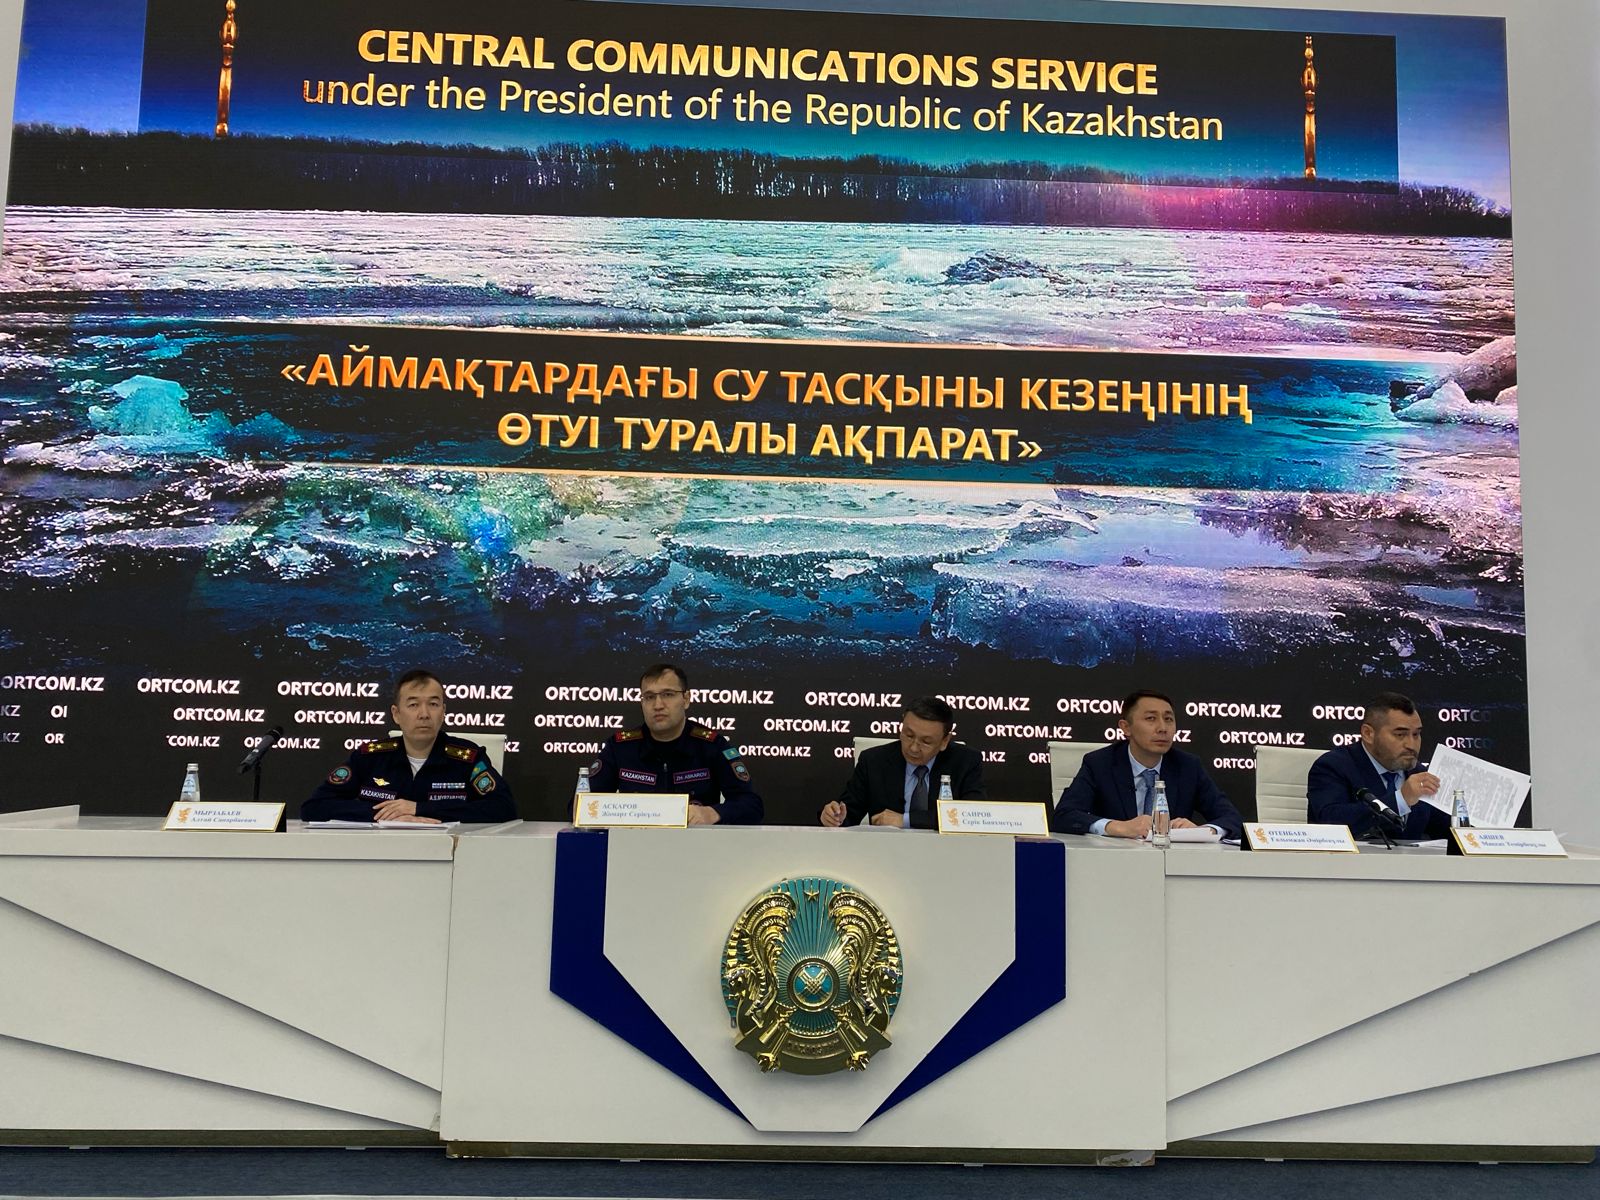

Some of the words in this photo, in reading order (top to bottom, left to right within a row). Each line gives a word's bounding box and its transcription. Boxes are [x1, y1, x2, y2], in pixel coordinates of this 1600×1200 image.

[359, 30, 554, 70] CENTRAL
[567, 40, 978, 88] COMMUNICATIONS
[992, 58, 1157, 94] SERVICE
[304, 74, 413, 106] under
[427, 77, 485, 108] the
[501, 81, 669, 118] President
[685, 88, 721, 118] of
[735, 90, 791, 121] the
[807, 94, 959, 132] Republic
[974, 100, 1010, 130] of
[1024, 103, 1221, 139] Kazakhstan
[281, 345, 697, 404] «АЙМАҚТАРДАҒЫ
[714, 369, 768, 401] СУ
[780, 371, 1003, 413] ТАСҚЫНЫ
[1022, 378, 1252, 423] КЕЗЕҢІНІҢ
[498, 413, 599, 448] ӨТУІ
[614, 417, 796, 454] ТУРАЛЫ
[811, 425, 1041, 464] АҚПАРАТ»
[1, 676, 104, 691] ORTCOM.KZ
[137, 678, 240, 694] ORTCOM.KZ
[278, 681, 379, 697] ORTCOM.KZ
[443, 685, 513, 699] COM.KZ
[690, 689, 774, 704] RTCOM.KZ
[805, 692, 901, 707] ORTCOM.KZ
[1186, 703, 1282, 718] ORTCOM.KZ
[1313, 706, 1365, 720] ORTCO
[174, 708, 264, 722] ORTCOM.KZ
[294, 710, 385, 724] ORTCOM.KZ
[444, 713, 505, 726] COM.KZ
[535, 715, 623, 728] ORTCOM.KZ
[764, 719, 850, 732] ORTCOM.KZ
[985, 724, 1072, 738] ORTCOM.KZ
[1220, 731, 1305, 745] ORTCOM.KZ
[166, 736, 220, 747] COM.KZ
[544, 742, 605, 753] ORTCOM.
[739, 745, 810, 757] ORTCOM.KZ
[1214, 758, 1256, 769] ORTCO
[360, 789, 396, 800] KAZAKHSTAN
[621, 771, 656, 783] KAZAKHSTAN
